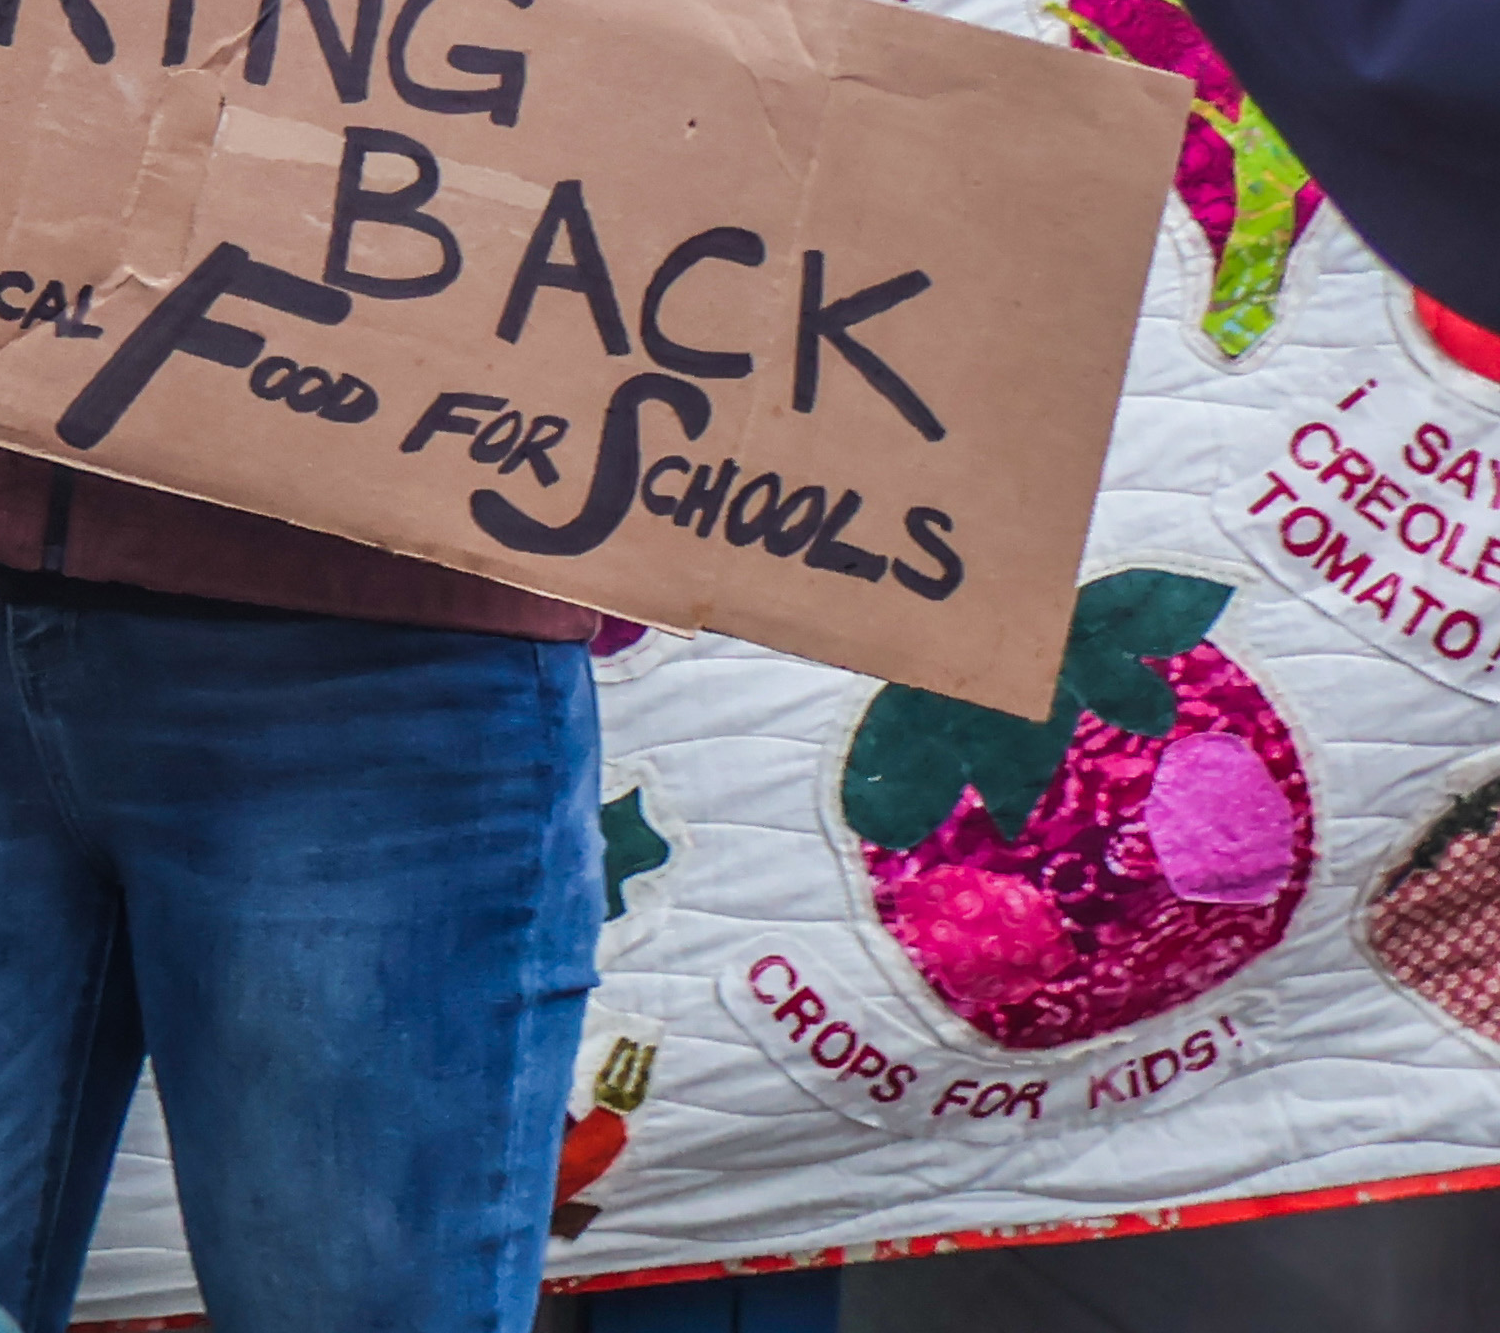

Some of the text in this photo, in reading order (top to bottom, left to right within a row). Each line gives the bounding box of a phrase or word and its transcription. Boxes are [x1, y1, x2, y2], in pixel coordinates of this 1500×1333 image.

[56, 241, 380, 449] FOOD
[324, 123, 946, 445] BACK
[400, 389, 562, 487] FOR
[468, 371, 966, 603] SCHOOLS
[746, 953, 919, 1104] CROPS
[930, 1077, 1050, 1121] FOR
